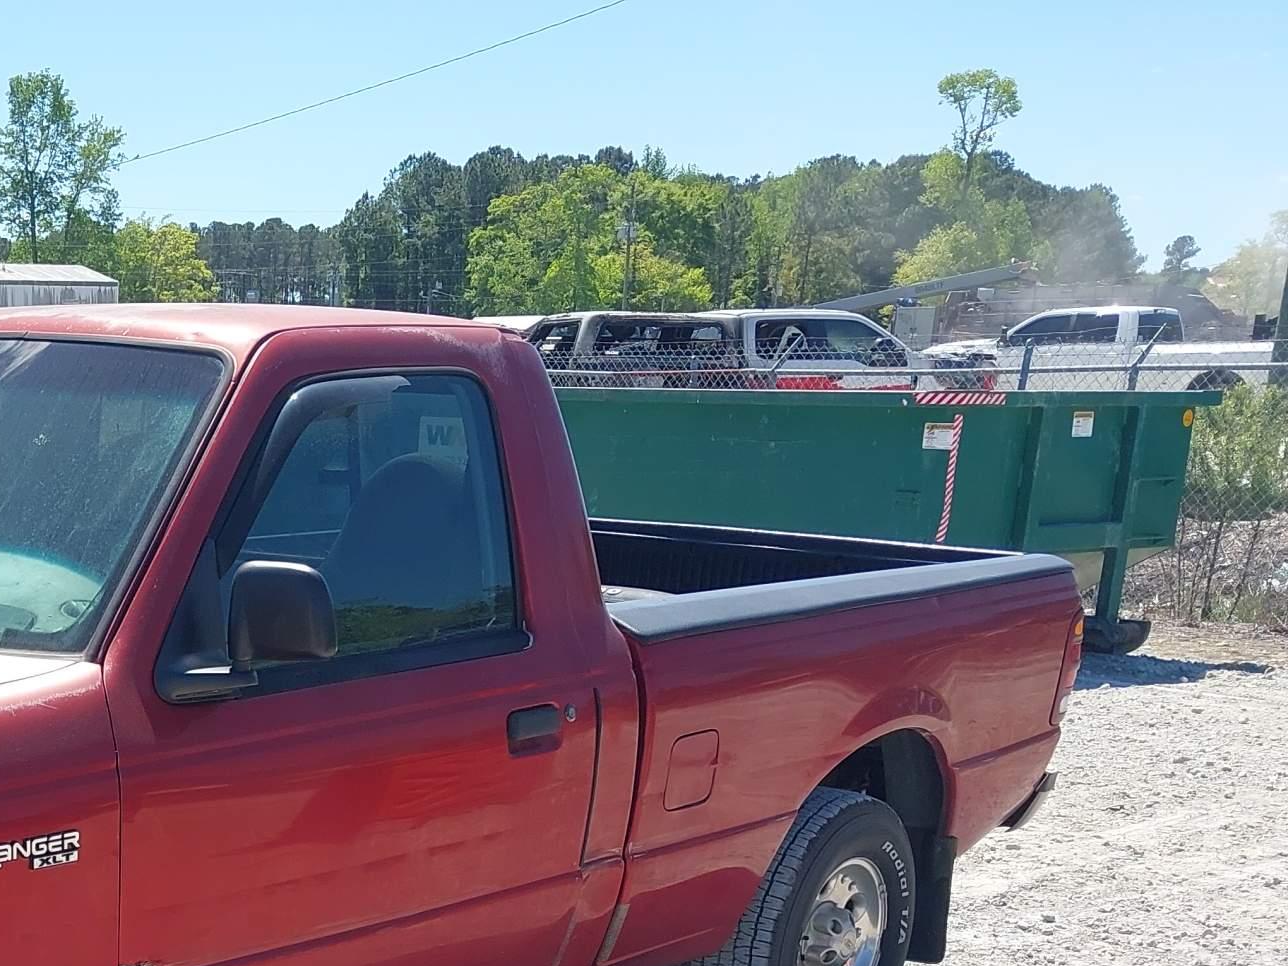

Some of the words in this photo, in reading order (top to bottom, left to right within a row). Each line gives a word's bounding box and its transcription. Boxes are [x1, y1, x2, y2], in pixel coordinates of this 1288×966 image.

[38, 852, 74, 867] XLT
[881, 841, 910, 897] Radial
[897, 906, 910, 945] T/A
